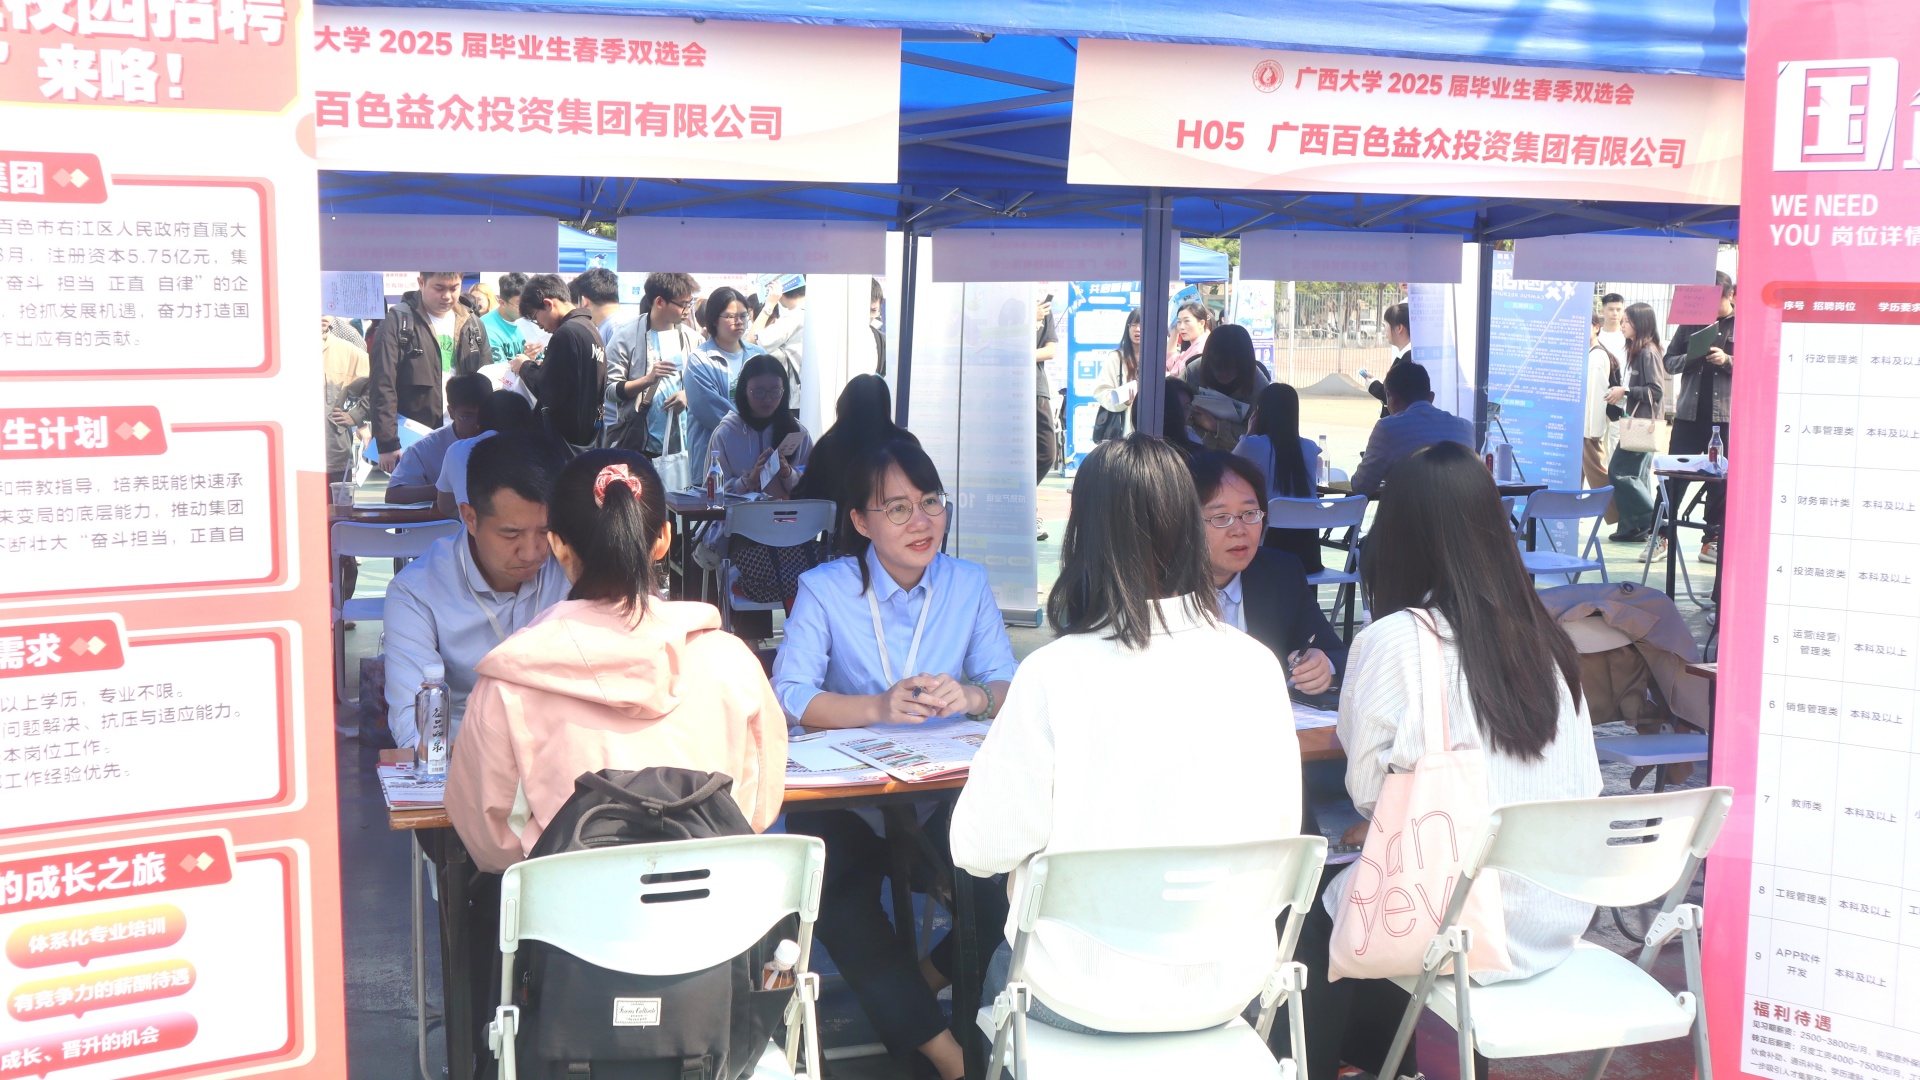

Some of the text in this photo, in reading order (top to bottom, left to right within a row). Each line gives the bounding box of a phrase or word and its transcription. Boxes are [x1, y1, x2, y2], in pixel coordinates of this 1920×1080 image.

[314, 25, 707, 67] 大学 2025 届毕业生春季双选会
[1295, 67, 1383, 93] 广西大学
[1388, 71, 1443, 96] 2025
[1448, 76, 1636, 106] 届毕业生春季双选会
[315, 90, 784, 141] 百色益众投资集团有限公司
[1773, 57, 1920, 171] 国
[1176, 119, 1687, 170] H05 广西百色益众投资集团有限公司
[1771, 194, 1879, 217] WE NEED
[0, 218, 247, 240] 百色市右江区人民政府直属大
[1770, 224, 1920, 247] YOU 岗位详情
[57, 275, 95, 292] 担当
[108, 275, 145, 292] 正直
[1783, 300, 1920, 313] 序号 招聘岗位 学历要求
[1805, 353, 1858, 365] 行政管理类
[2, 416, 108, 450] 生计划
[1784, 424, 1920, 440] 2 人事管理类 本科及以上
[1780, 495, 1915, 512] 3 财务审计类 本科及以上
[1776, 565, 1911, 585] 4 投资融资类 本科及以上
[0, 632, 62, 669] 需求
[1773, 635, 1779, 644] 5
[1853, 643, 1907, 657] 本科及以上
[1800, 645, 1831, 657] 管理类
[1769, 700, 1903, 725] 6 销售管理类 本科及以上
[0, 763, 130, 790] 工作经验优先。
[1764, 795, 1897, 823] 7 教师类 本科及以上
[0, 851, 166, 905] 的成长之旅
[1759, 885, 1765, 894] 8
[1776, 888, 1827, 906] 工程管理类
[1839, 900, 1891, 918] 本科及以上
[28, 916, 166, 955] 体系化专业培训
[1755, 948, 1887, 988] 9 APP软件 本科及以上
[1786, 965, 1808, 979] 开发
[13, 967, 191, 1014] 有竞争力的薪酬待遇
[1753, 1000, 1832, 1033] 福利待遇
